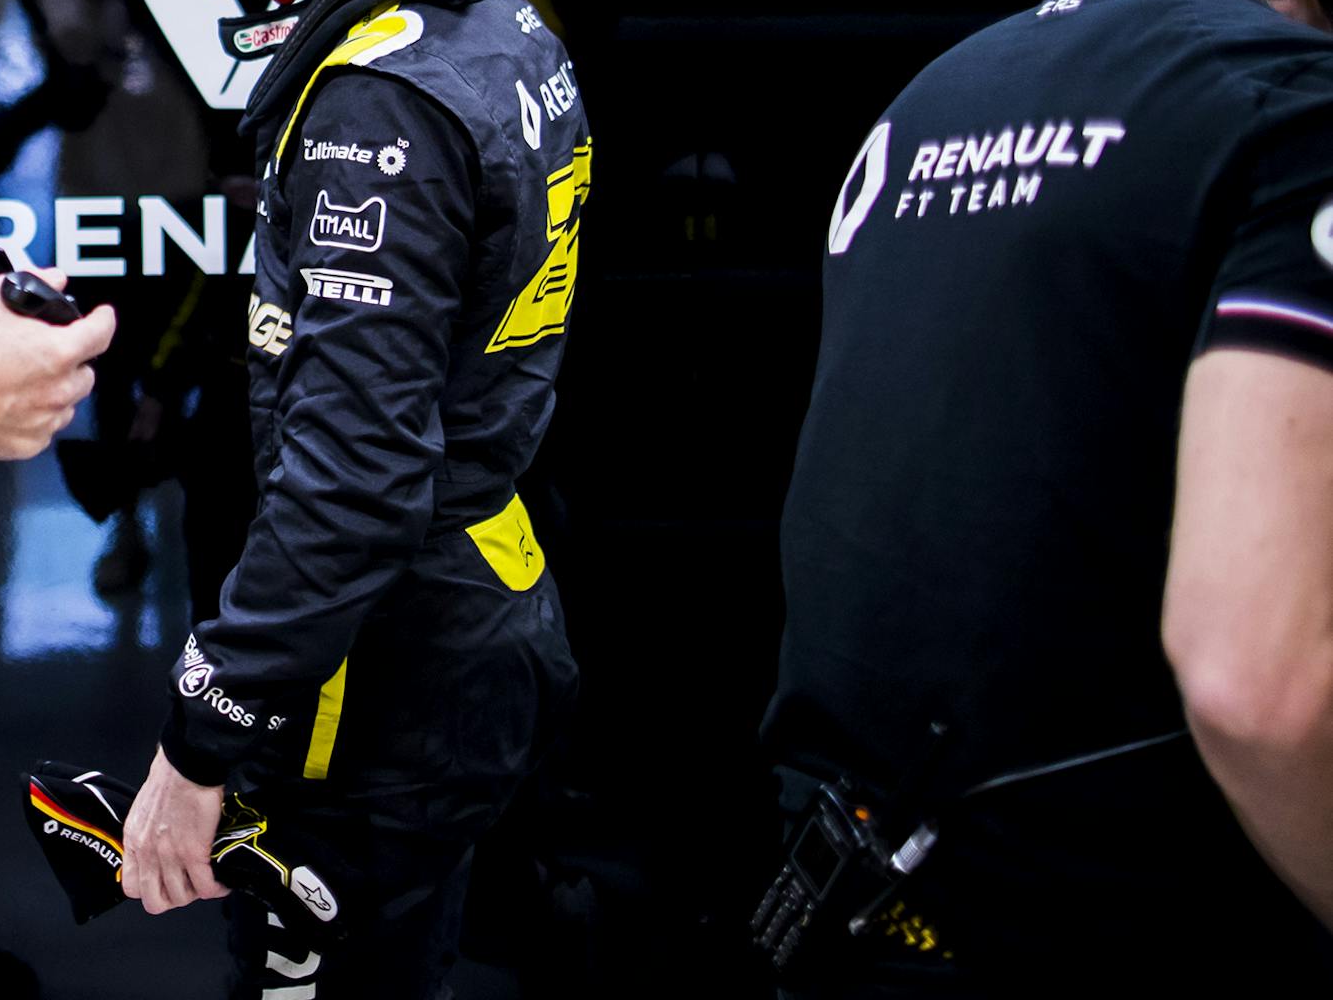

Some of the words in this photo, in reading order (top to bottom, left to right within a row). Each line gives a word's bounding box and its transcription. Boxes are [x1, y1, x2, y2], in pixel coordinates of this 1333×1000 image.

[253, 21, 300, 48] Castro
[396, 137, 410, 150] bp
[908, 122, 1126, 182] RENAULT
[895, 190, 934, 218] F1
[949, 172, 1043, 216] TEAM
[316, 214, 375, 241] TMALL
[60, 828, 123, 868] RENAULT
